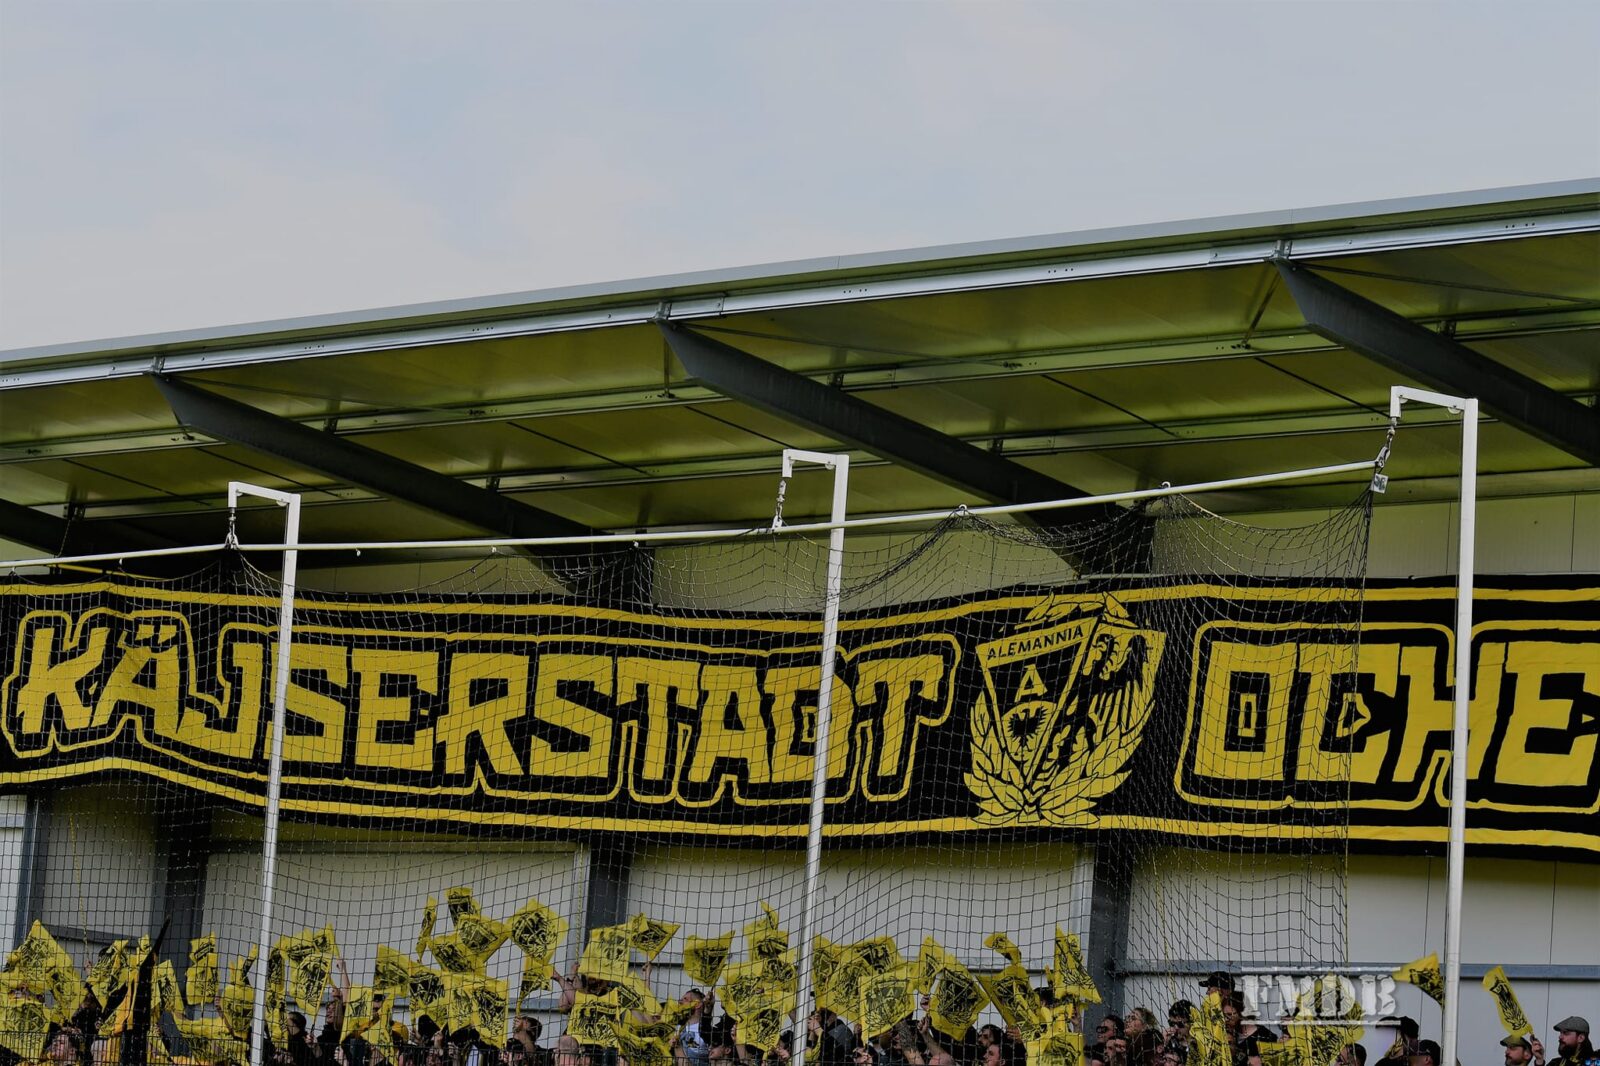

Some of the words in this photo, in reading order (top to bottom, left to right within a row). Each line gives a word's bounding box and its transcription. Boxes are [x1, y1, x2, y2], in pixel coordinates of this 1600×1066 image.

[986, 624, 1085, 661] ALEMANNIA
[1015, 664, 1048, 703] A
[1193, 640, 1600, 787] OCHE
